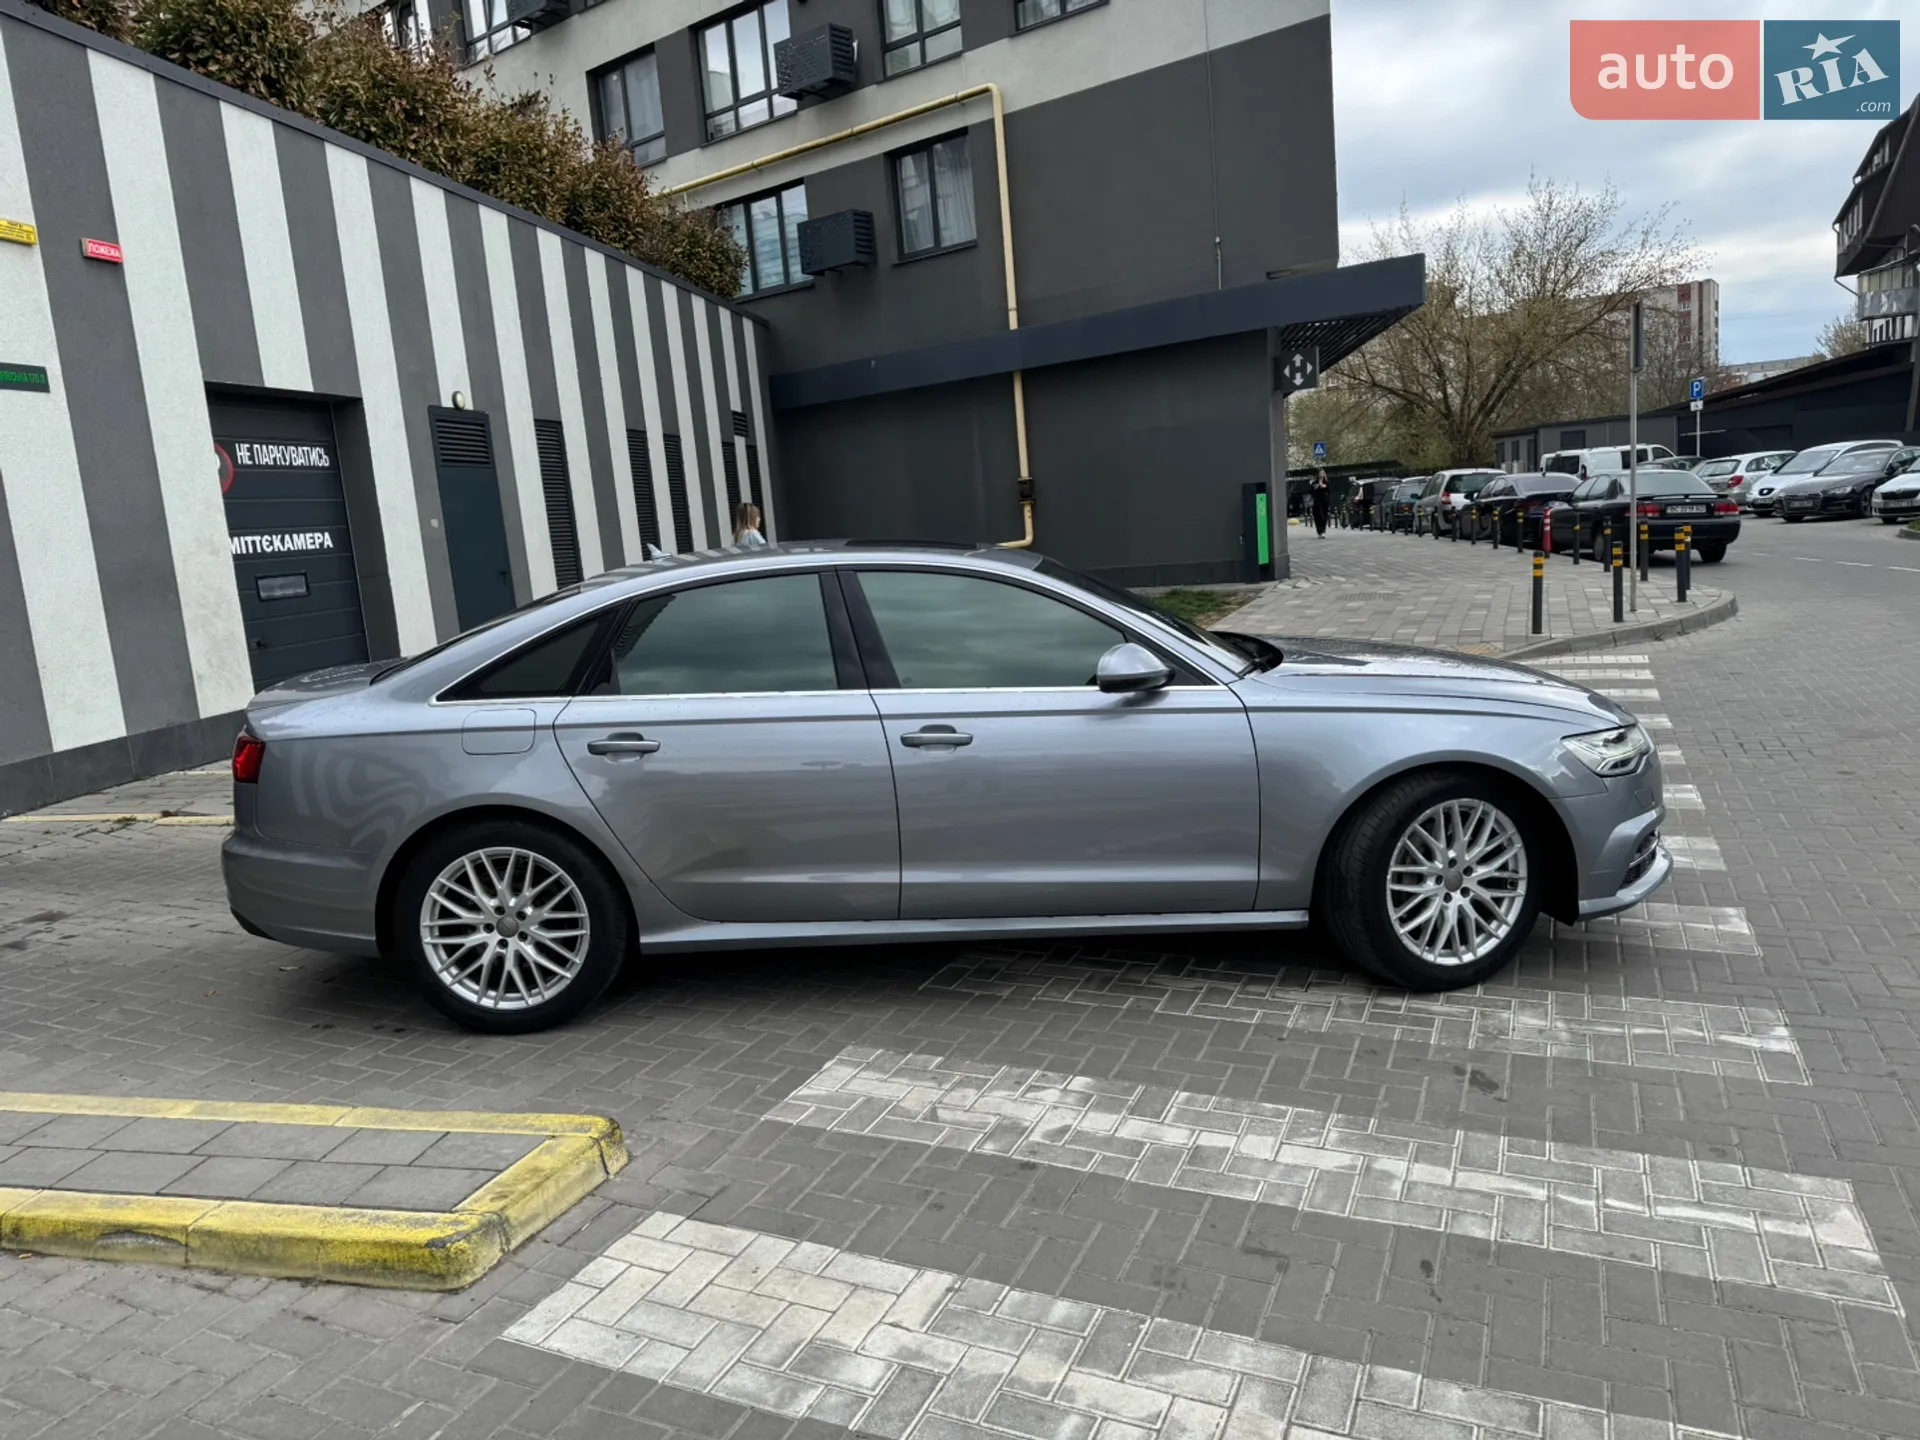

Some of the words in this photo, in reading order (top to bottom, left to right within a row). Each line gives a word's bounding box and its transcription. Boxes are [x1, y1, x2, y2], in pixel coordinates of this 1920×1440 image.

[1693, 381, 1702, 397] P
[235, 443, 253, 465] НЕ
[253, 444, 330, 467] ПАРКУВАТИСЬ
